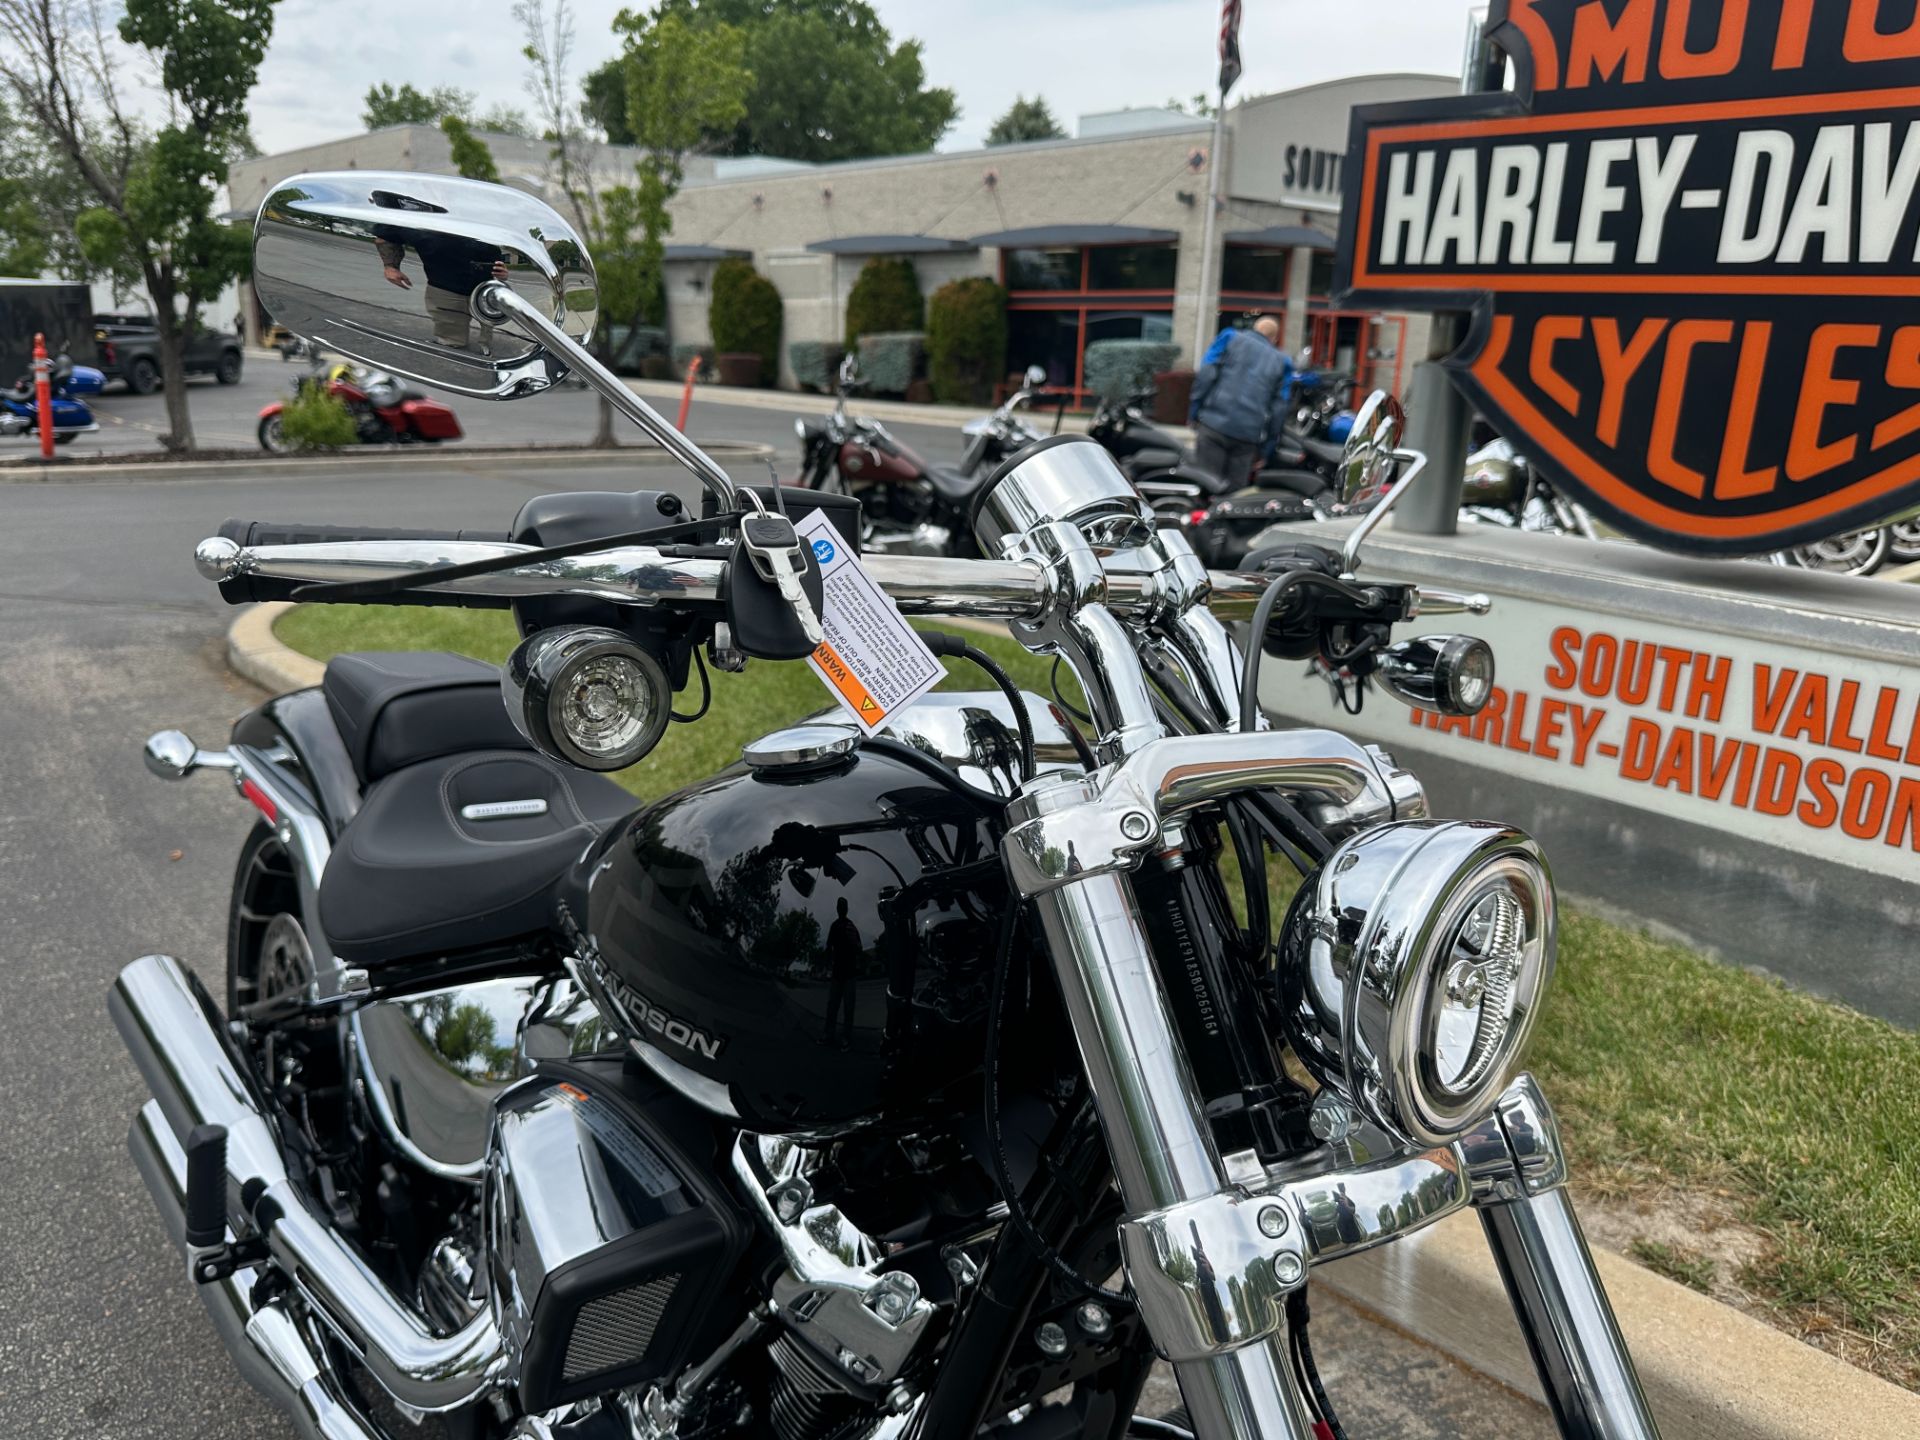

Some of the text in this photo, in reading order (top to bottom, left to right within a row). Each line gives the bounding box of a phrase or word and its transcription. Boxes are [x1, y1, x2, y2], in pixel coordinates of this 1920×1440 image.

[1283, 145, 1346, 194] SOUT
[1378, 120, 1920, 265] HARLEY-DAV
[841, 581, 851, 592] part
[849, 591, 859, 601] any
[837, 634, 847, 645] OF
[854, 629, 867, 644] death
[844, 643, 858, 658] OUT
[821, 626, 889, 708] CONTAINS BUTTON OR COIN
[855, 656, 872, 675] KEEP
[1545, 625, 1733, 723] SOUTH
[874, 666, 901, 698] CHILDREN
[1409, 685, 1920, 854] RLEY-DAVIDSON
